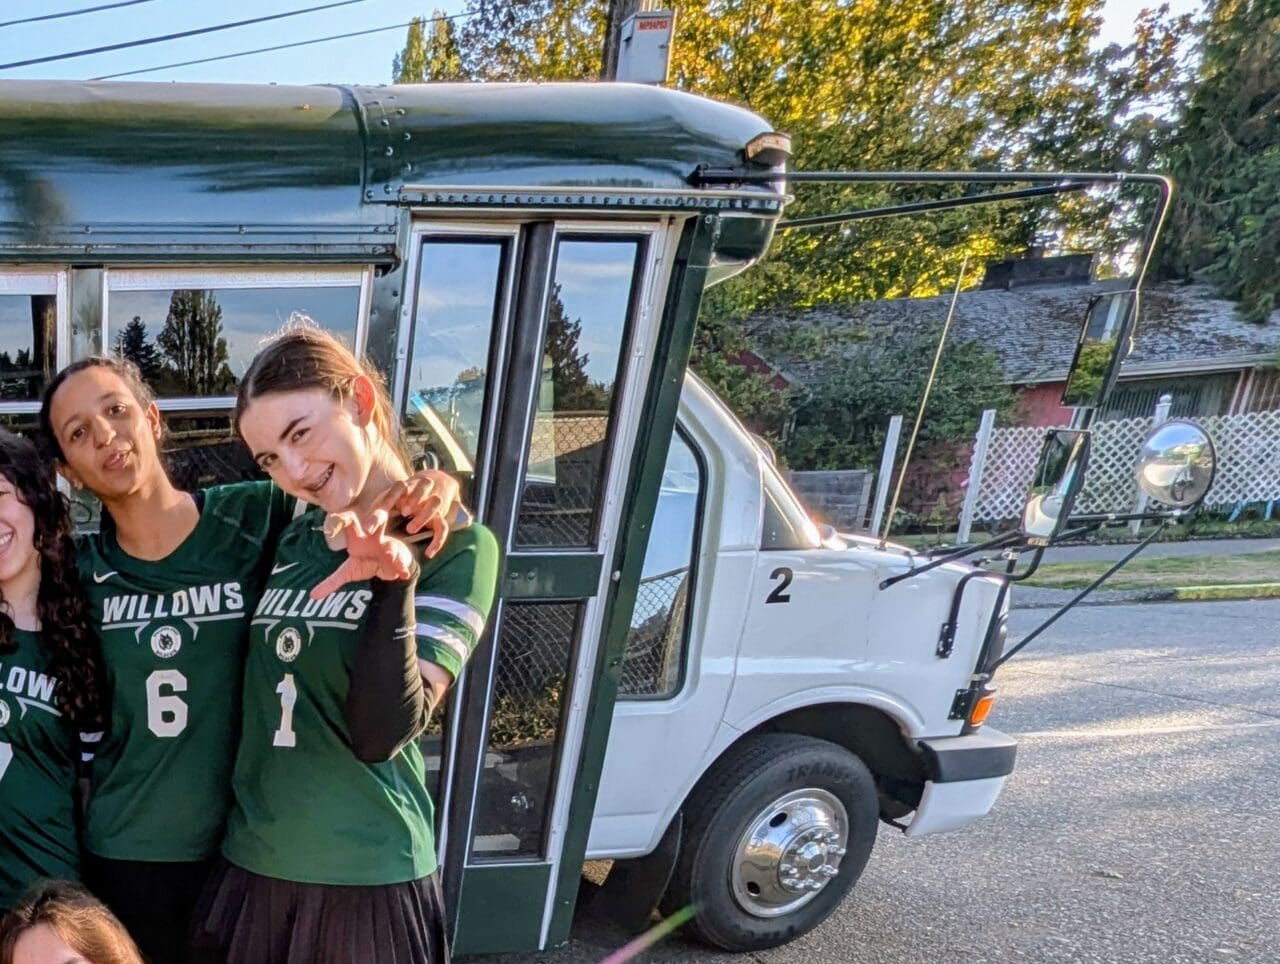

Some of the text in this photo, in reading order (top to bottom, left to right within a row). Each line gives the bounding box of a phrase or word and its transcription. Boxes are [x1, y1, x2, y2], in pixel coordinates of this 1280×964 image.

[102, 582, 244, 623] WILLOWS
[765, 566, 793, 604] 2
[146, 669, 188, 738] 6
[273, 673, 297, 747] 1
